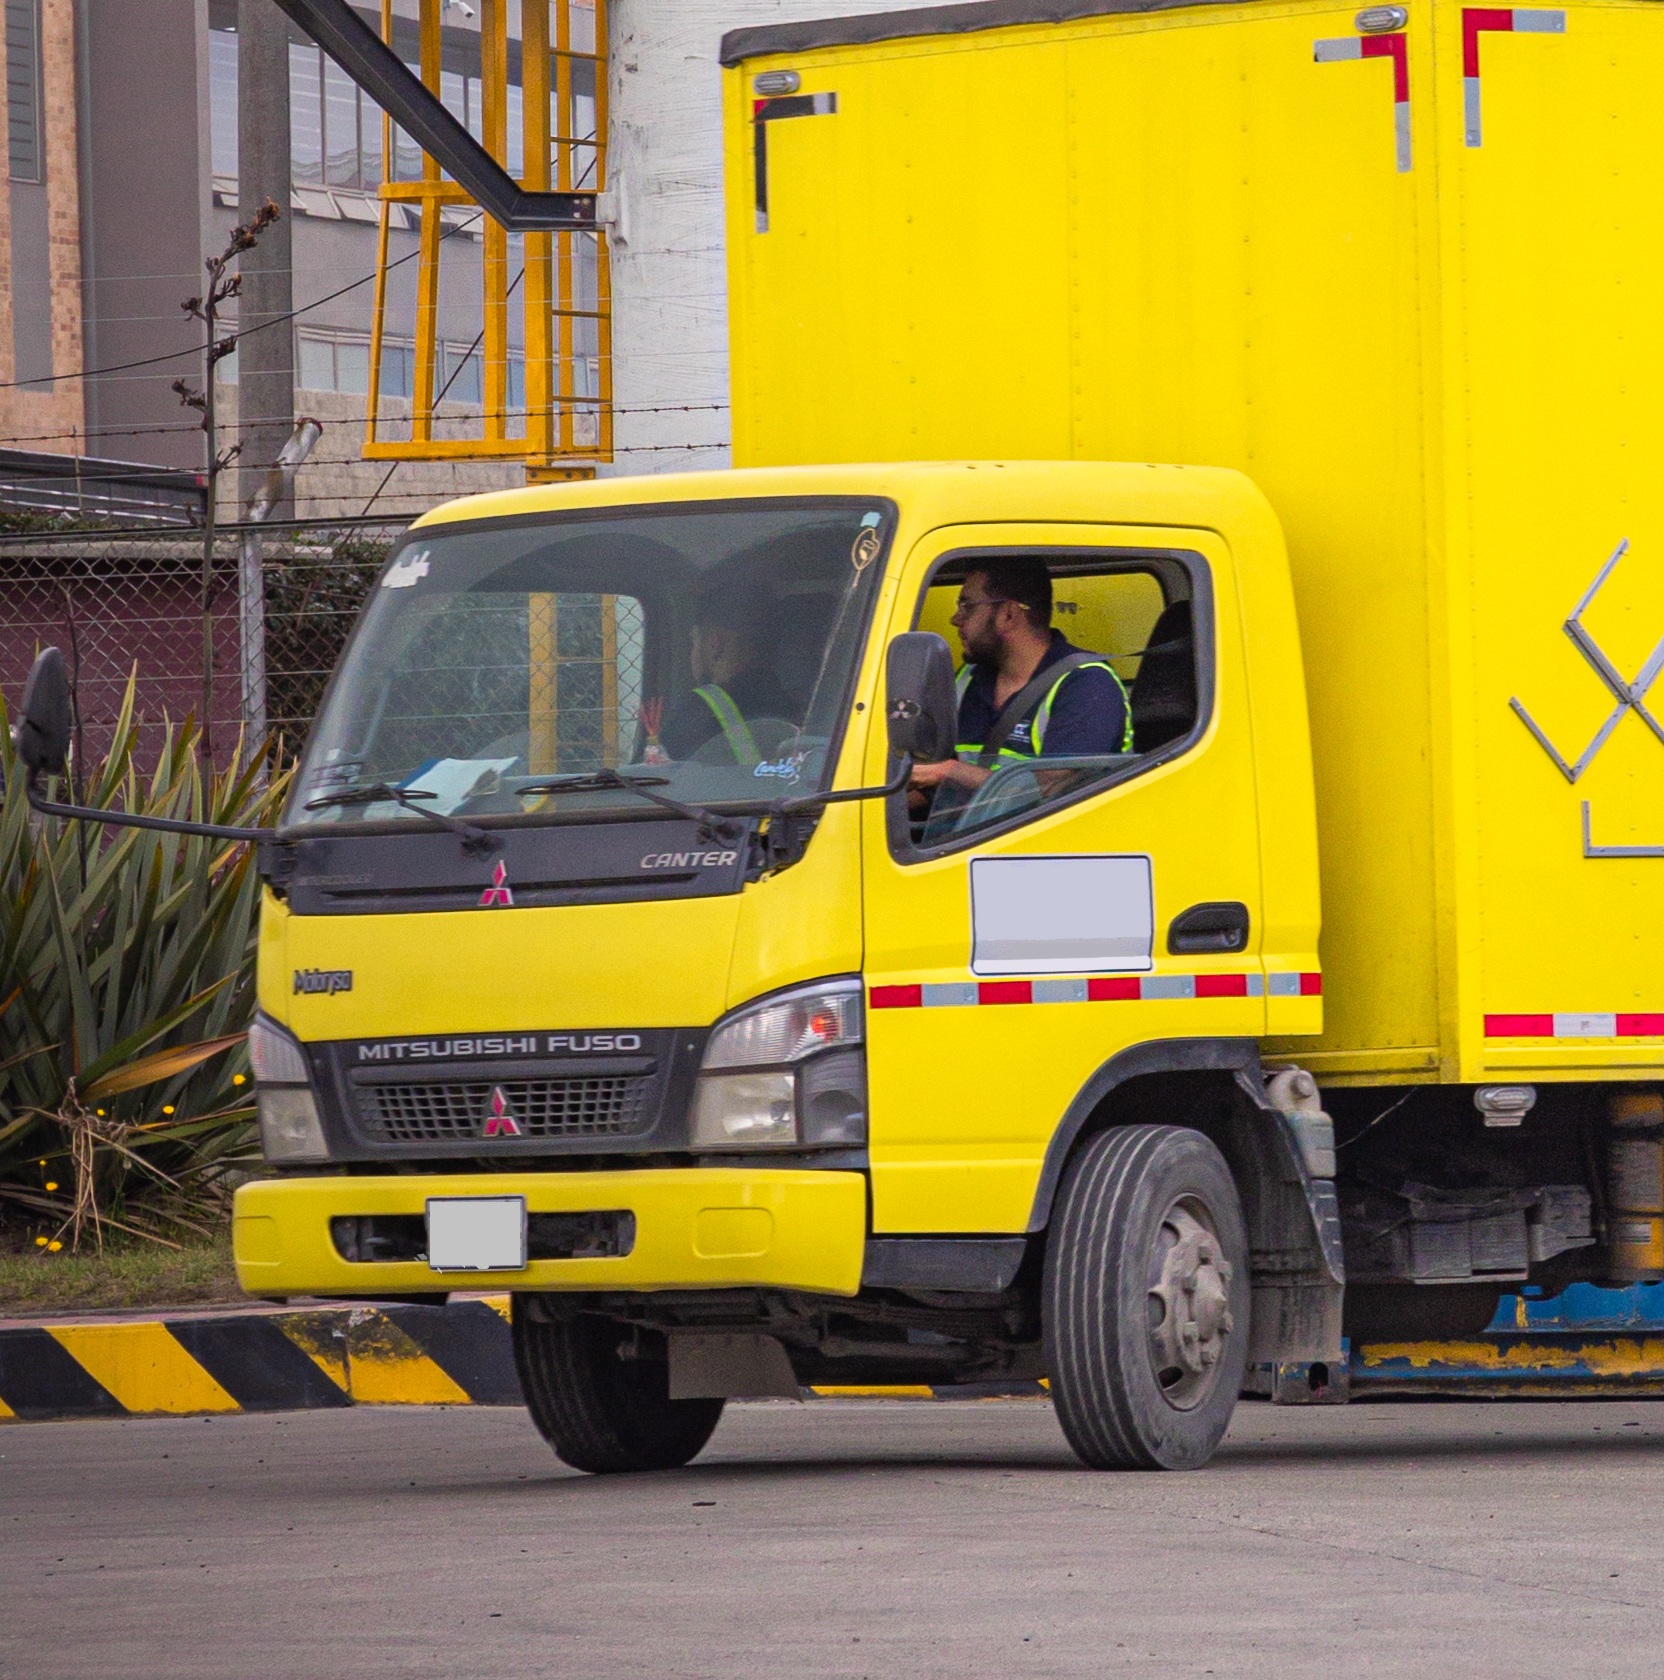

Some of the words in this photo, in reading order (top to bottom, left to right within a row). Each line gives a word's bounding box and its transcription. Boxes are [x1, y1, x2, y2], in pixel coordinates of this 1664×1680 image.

[640, 851, 738, 869] CANTER
[358, 1037, 536, 1060] MITSUBISHI
[547, 1034, 642, 1053] FUSO
